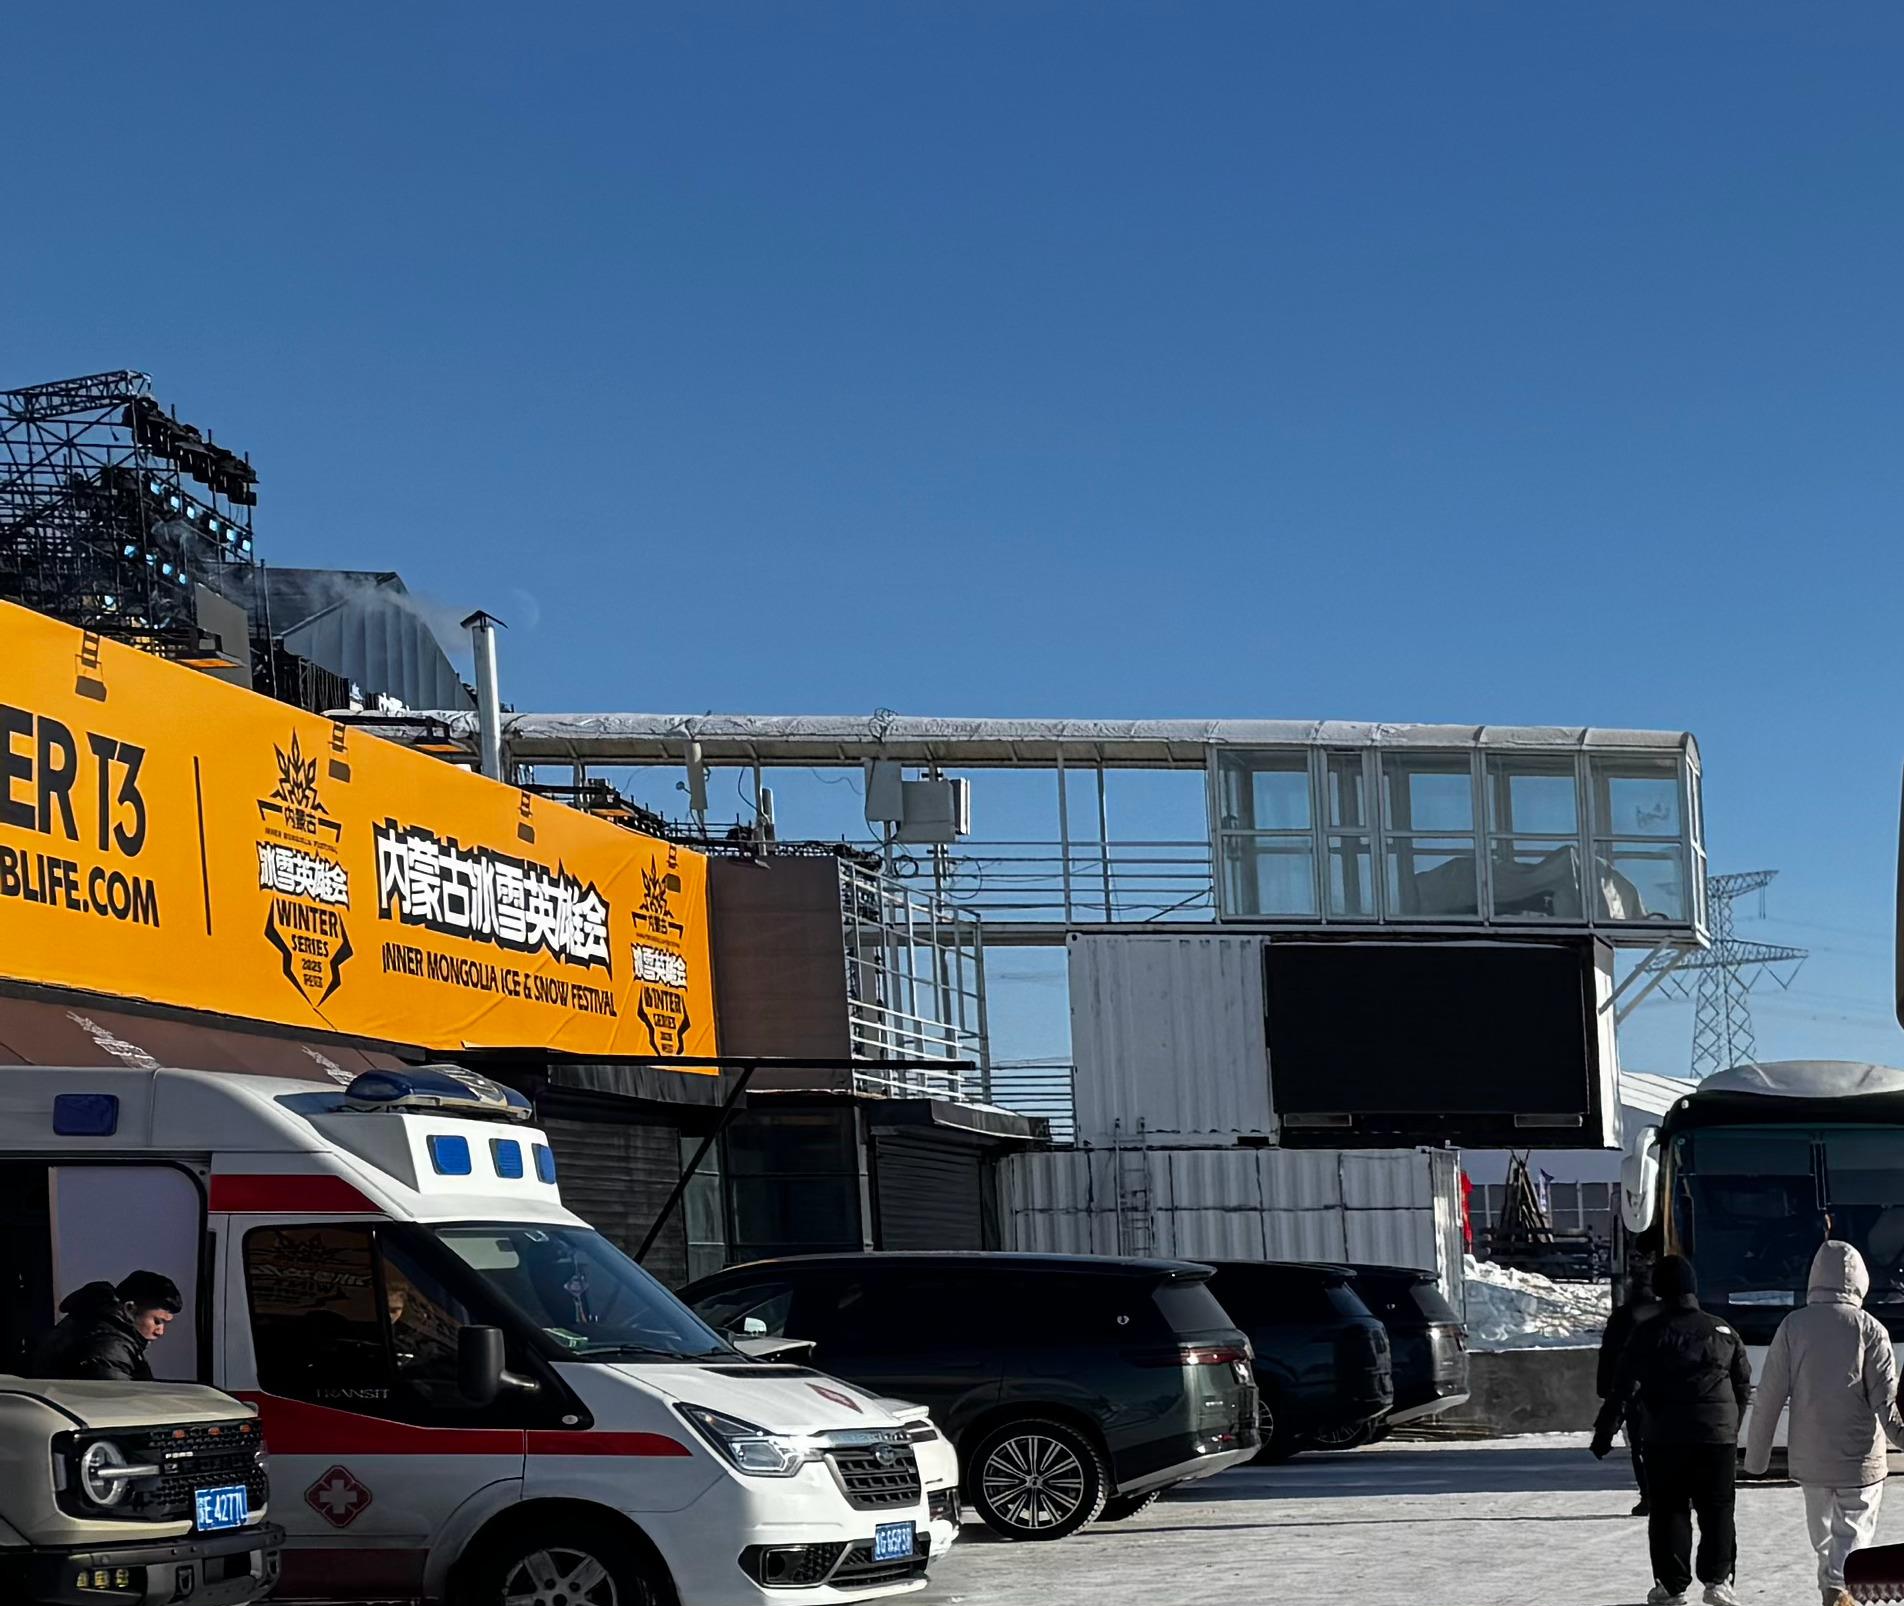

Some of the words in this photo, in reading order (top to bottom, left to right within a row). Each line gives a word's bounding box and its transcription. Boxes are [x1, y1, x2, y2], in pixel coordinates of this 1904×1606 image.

[86, 731, 146, 857] T3
[275, 897, 339, 939] WINTER
[291, 933, 329, 958] SERIES
[382, 942, 424, 980] INNER
[427, 951, 499, 994] MONGOLIA
[500, 967, 521, 997] ICE
[523, 973, 533, 999] &
[533, 975, 569, 1007] SNOW
[571, 983, 618, 1018] FESTIVAL
